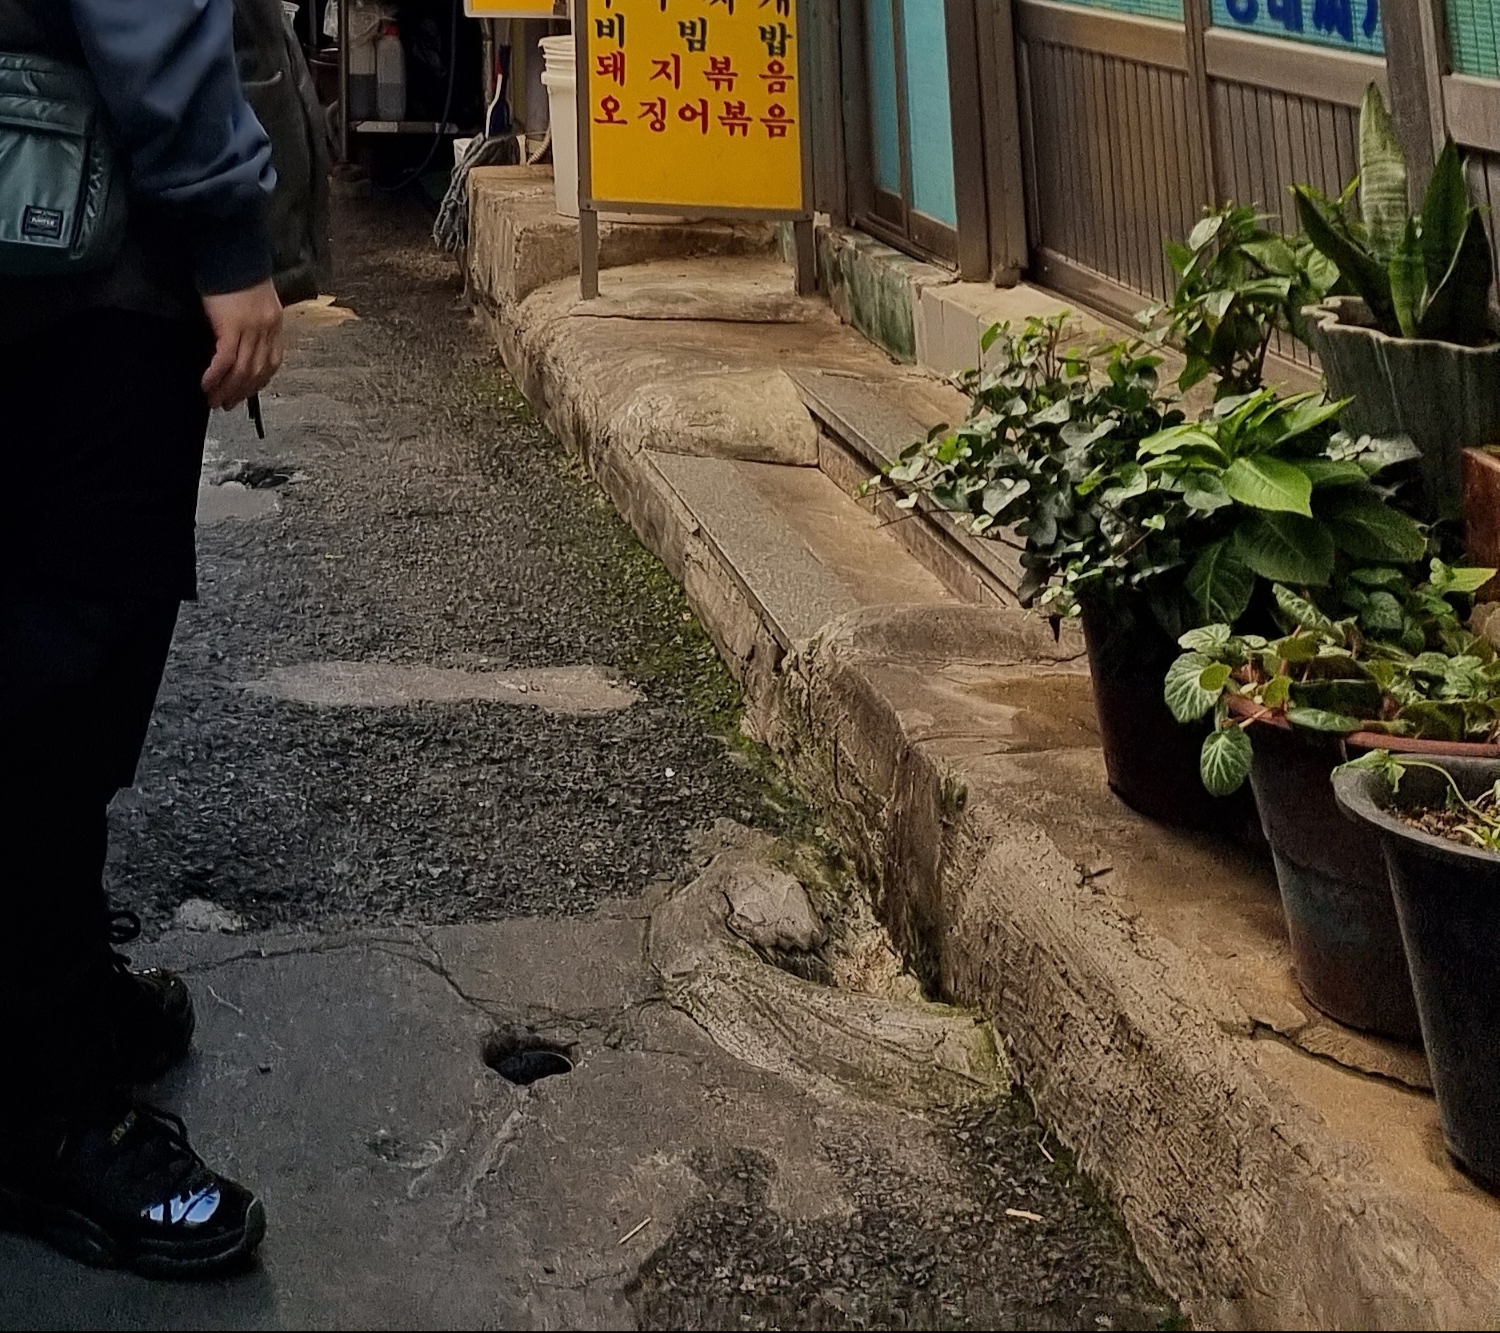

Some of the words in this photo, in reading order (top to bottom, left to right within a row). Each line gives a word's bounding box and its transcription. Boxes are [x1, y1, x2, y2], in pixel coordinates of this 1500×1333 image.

[594, 13, 794, 59] 비빔밥
[595, 50, 795, 94] 돼지볶음
[593, 95, 796, 139] 오징어볶음
